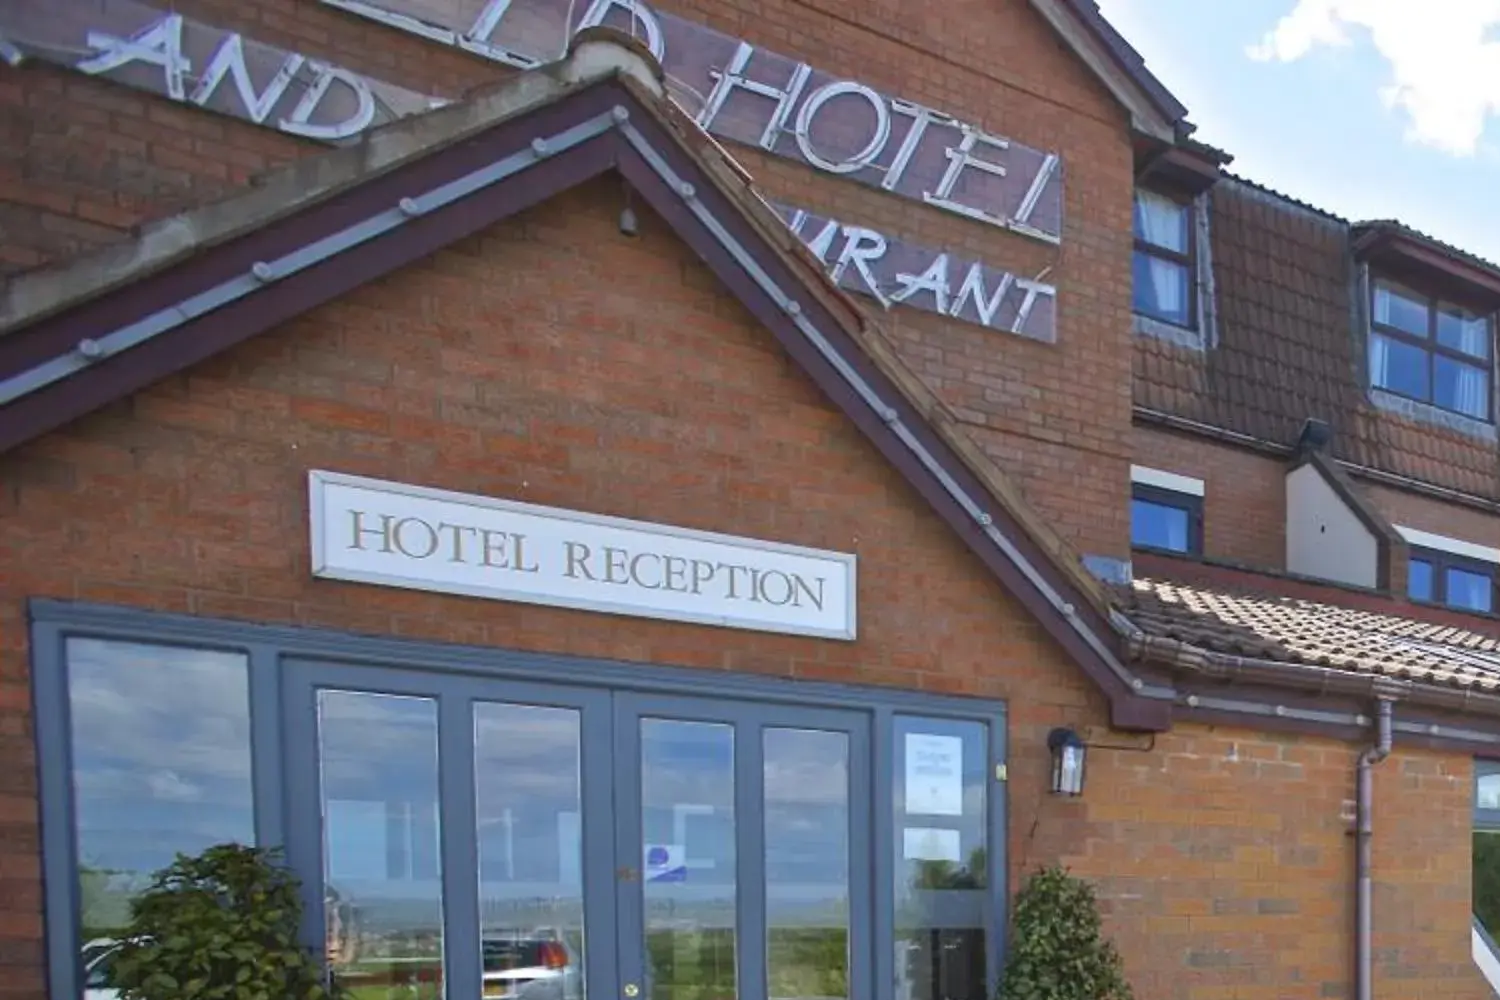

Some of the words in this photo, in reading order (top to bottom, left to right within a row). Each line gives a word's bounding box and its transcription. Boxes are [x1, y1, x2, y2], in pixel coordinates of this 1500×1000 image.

[77, 14, 377, 139] AND
[697, 41, 1061, 245] HOTEL
[347, 509, 540, 573] HOTEL
[563, 541, 827, 611] RECEPTION
